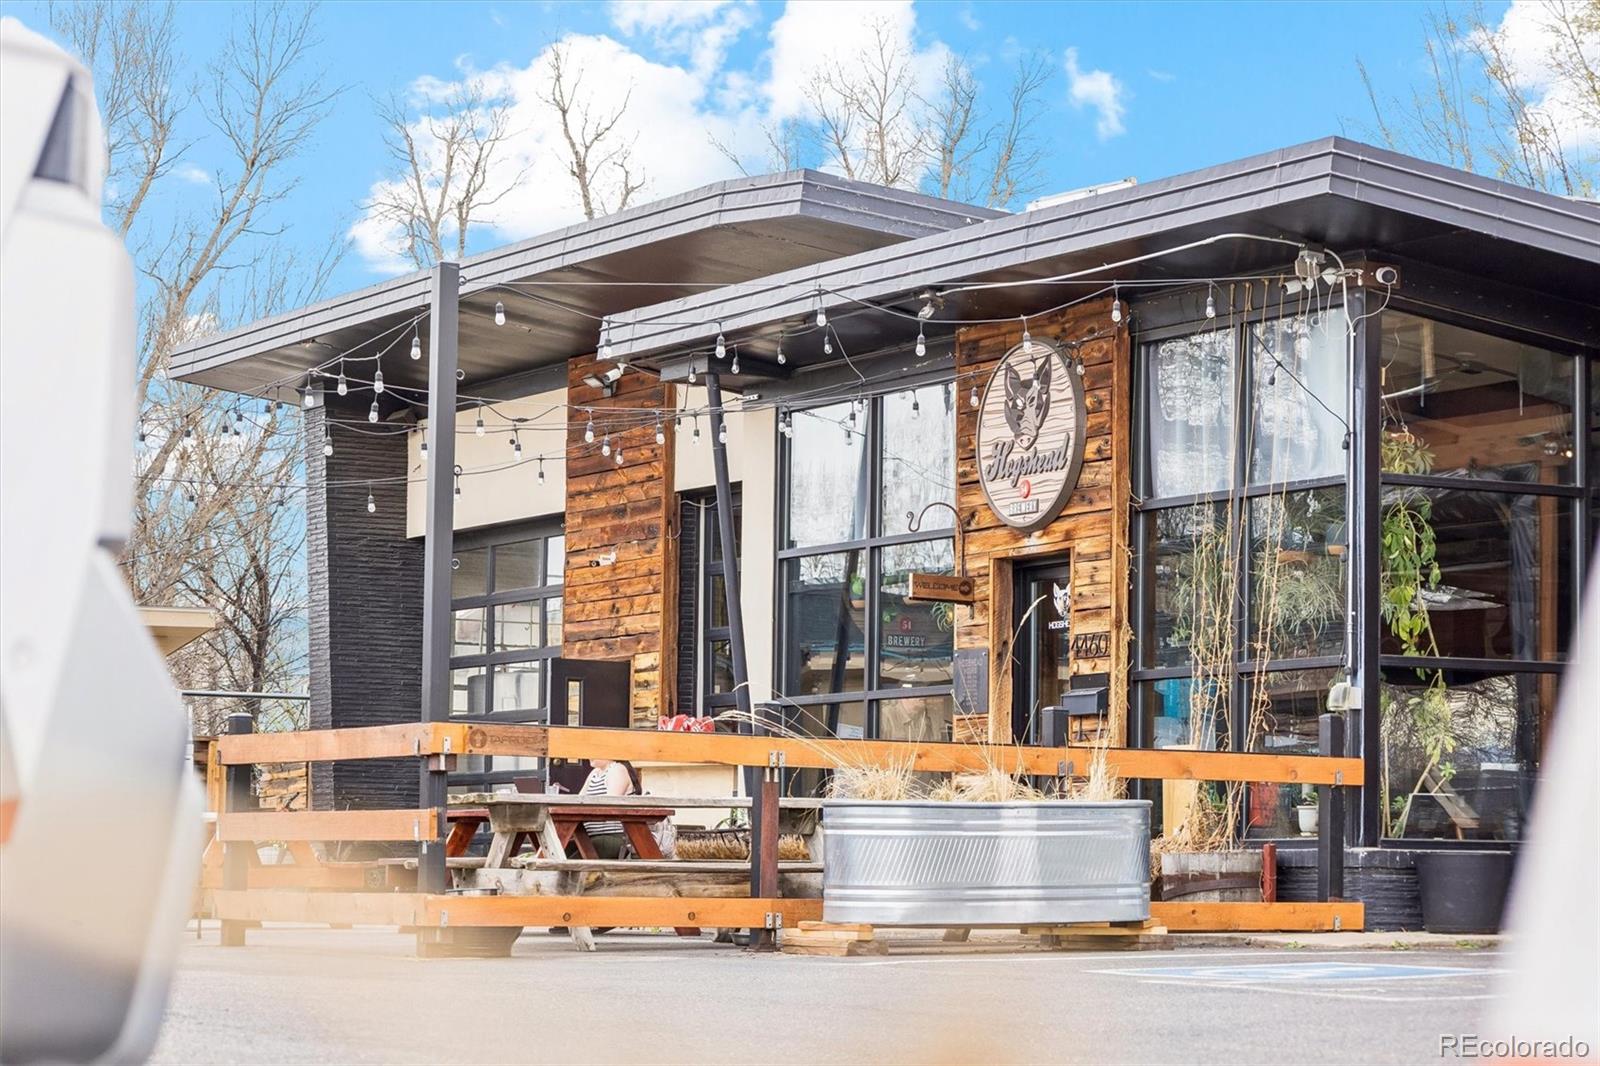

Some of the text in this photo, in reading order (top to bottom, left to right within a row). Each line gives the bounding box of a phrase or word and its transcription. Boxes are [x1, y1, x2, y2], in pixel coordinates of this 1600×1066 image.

[985, 432, 1070, 488] Hogshead
[914, 581, 960, 592] WELCOME
[1048, 620, 1070, 629] HOGSHE
[887, 635, 926, 647] BREWERY
